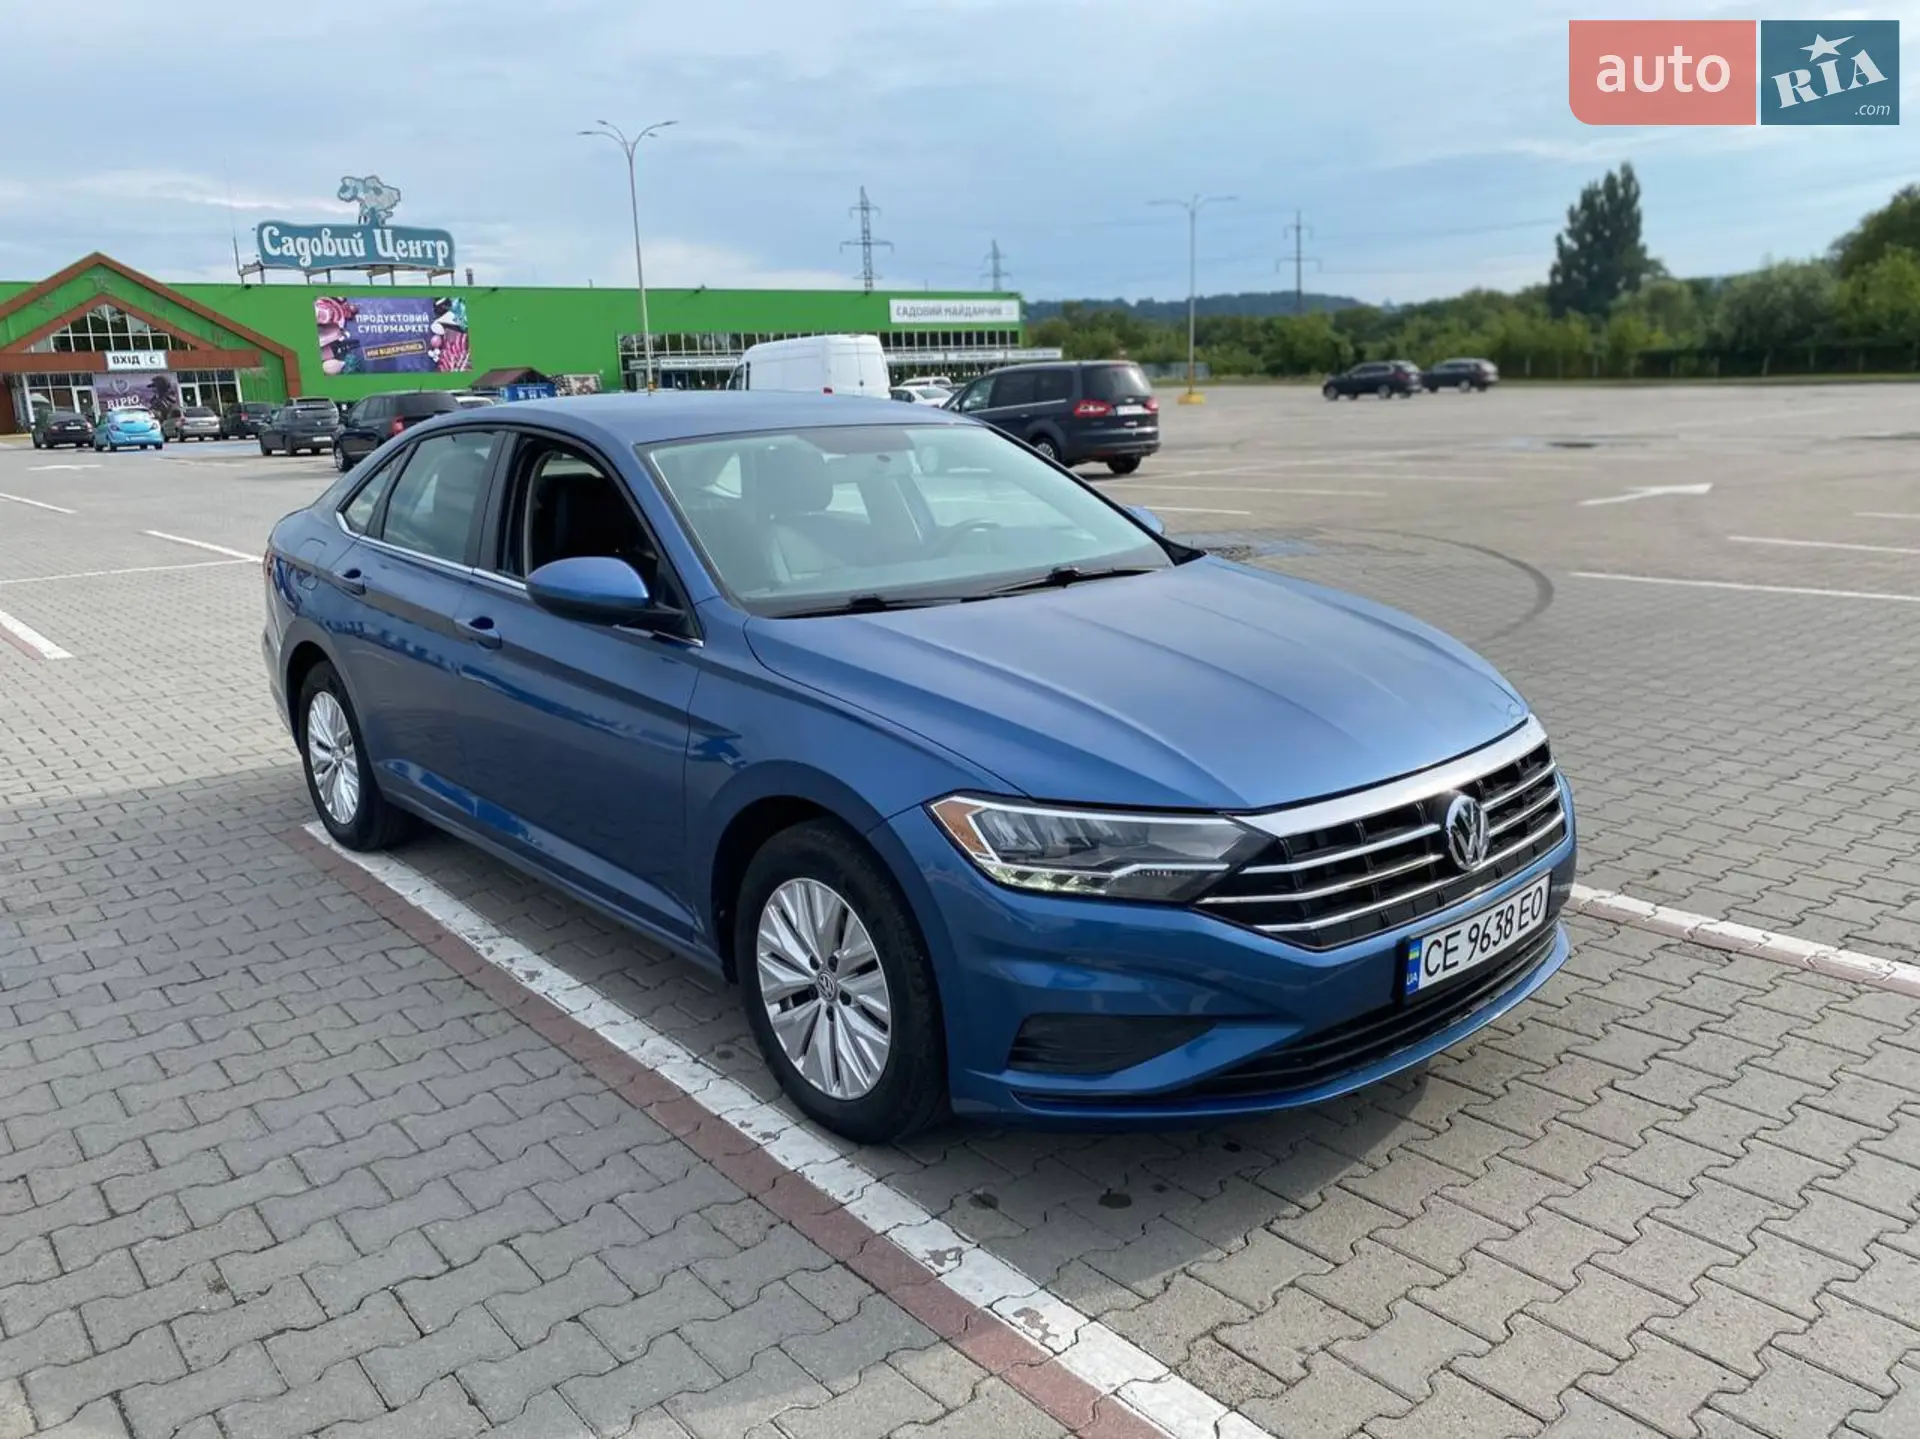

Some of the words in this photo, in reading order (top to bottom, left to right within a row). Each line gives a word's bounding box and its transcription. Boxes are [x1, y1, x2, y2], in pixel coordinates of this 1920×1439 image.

[262, 226, 366, 267] Садовий
[373, 229, 449, 266] Центр
[355, 312, 429, 323] ПРОДУКТОВИЙ
[358, 324, 429, 334] СУПЕРМАРКЕТ
[112, 355, 140, 364] ВХІД
[1424, 930, 1461, 977] CE
[1467, 904, 1515, 962] 9638
[1518, 886, 1543, 932] EO
